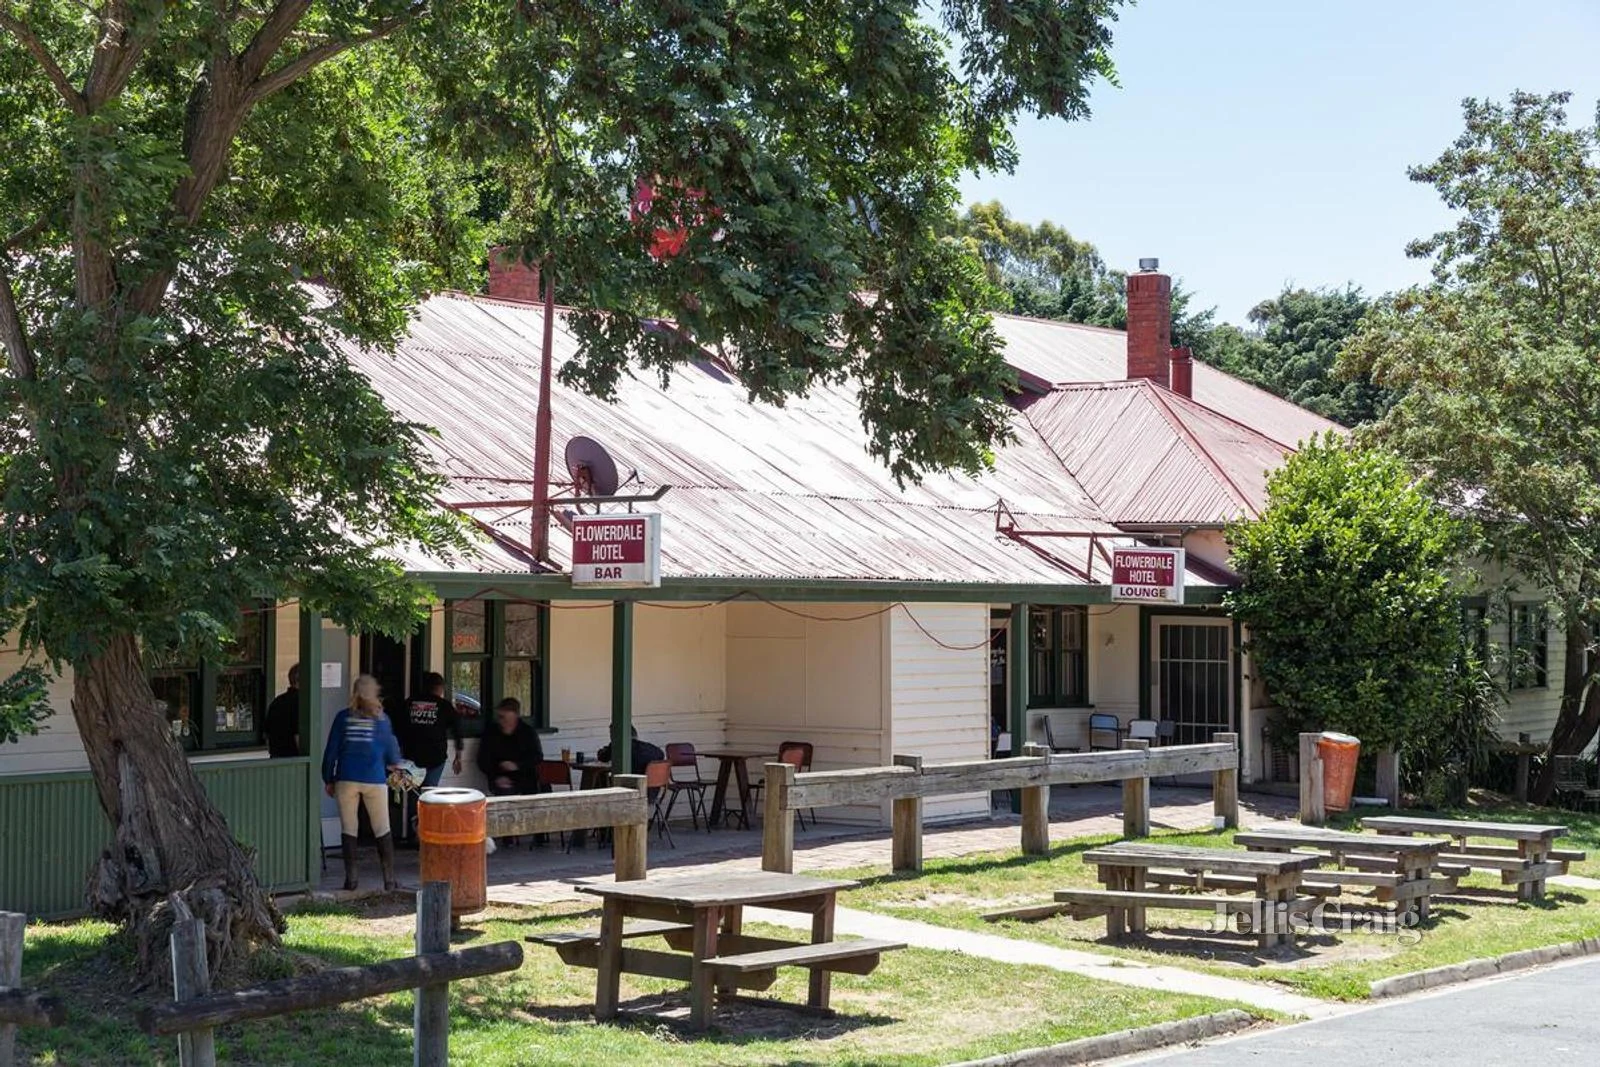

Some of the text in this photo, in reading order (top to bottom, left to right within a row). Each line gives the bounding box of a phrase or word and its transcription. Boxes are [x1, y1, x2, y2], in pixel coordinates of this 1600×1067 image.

[575, 524, 643, 541] FLOWERDALE
[592, 544, 625, 560] HOTEL
[1115, 554, 1172, 569] FLOWERDALE
[594, 567, 622, 579] BAR
[1129, 569, 1157, 583] HOTEL
[1120, 587, 1167, 598] LOUNGE
